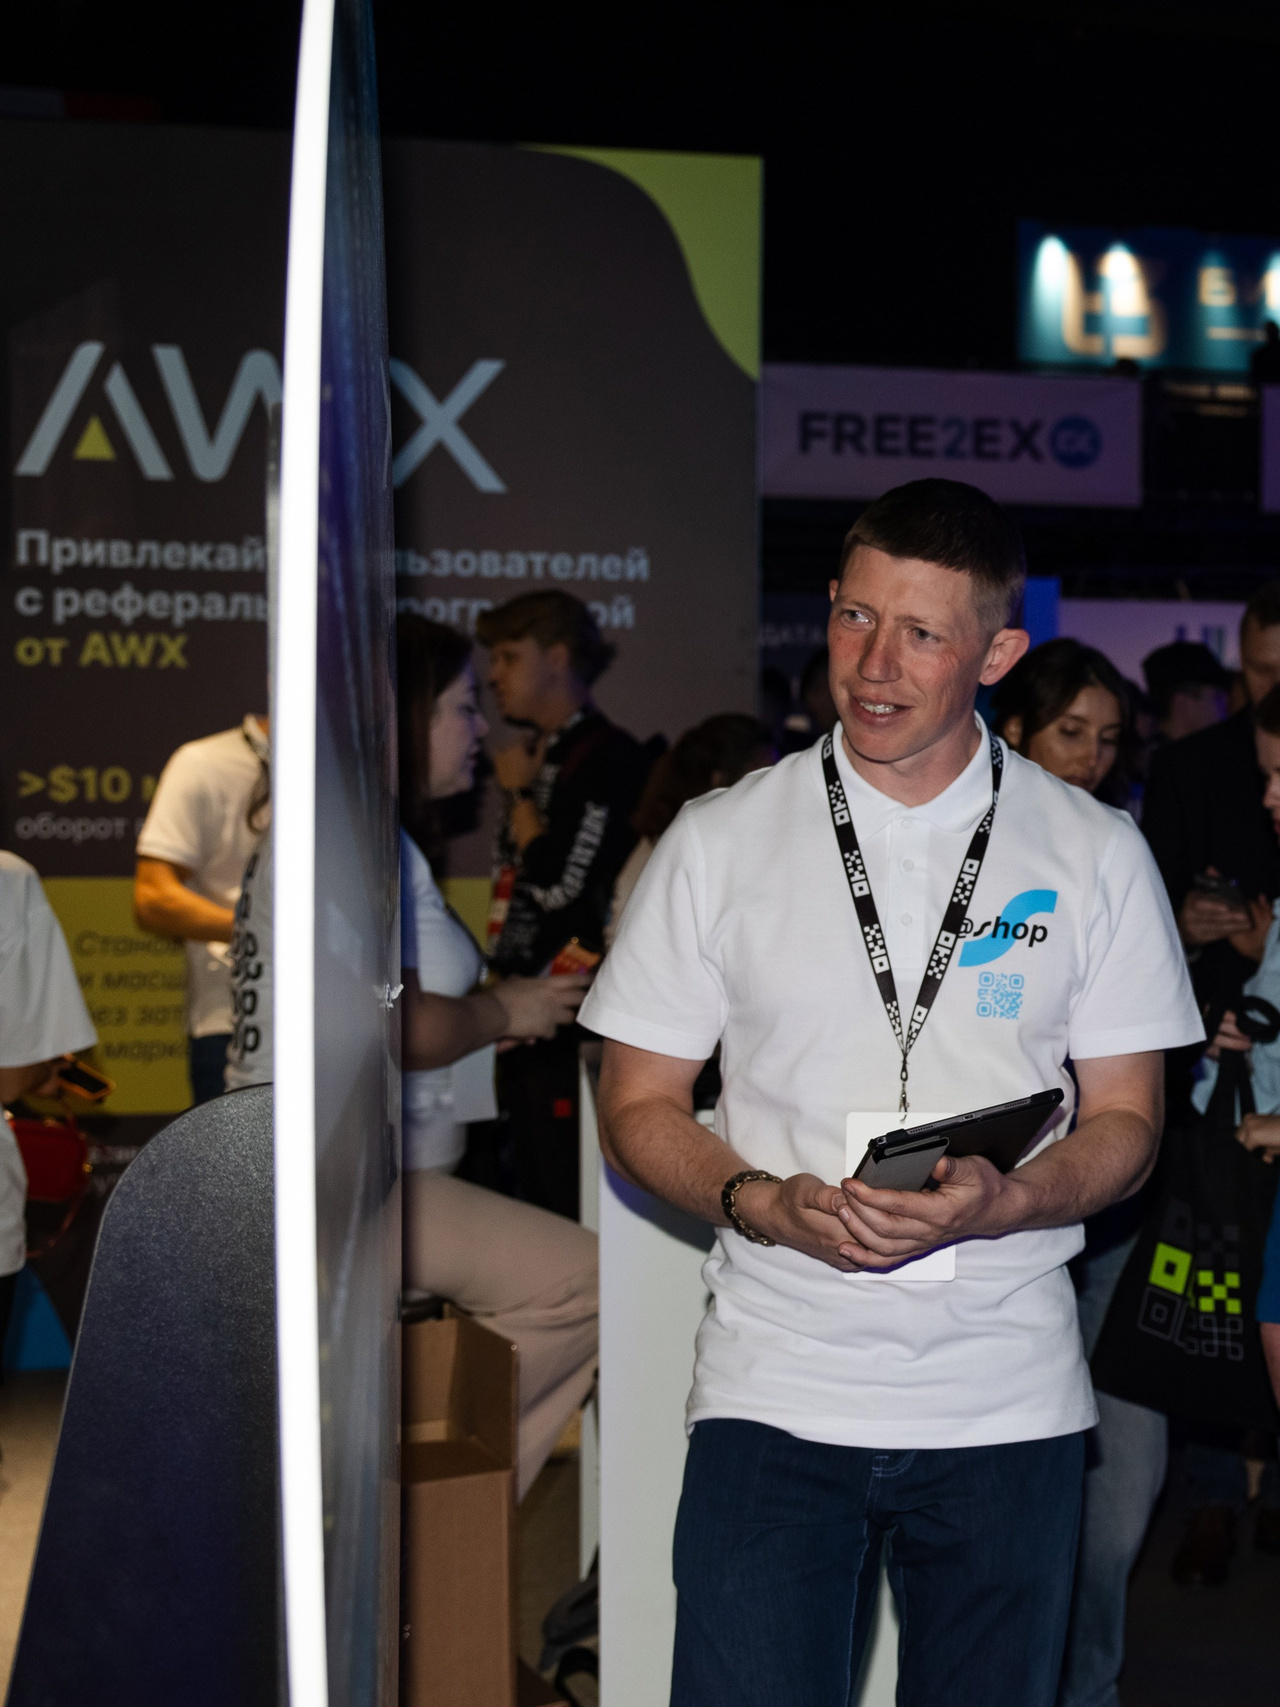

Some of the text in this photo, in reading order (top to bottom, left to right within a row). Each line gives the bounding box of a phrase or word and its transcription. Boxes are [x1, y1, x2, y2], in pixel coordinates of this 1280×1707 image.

[14, 340, 508, 494] AWX
[799, 410, 1044, 462] FREE2EX
[16, 528, 651, 583] Привлекай ьзователей
[14, 586, 44, 617] с
[54, 581, 267, 628] рефераль
[15, 631, 190, 669] от AWX
[14, 811, 131, 846] оборот
